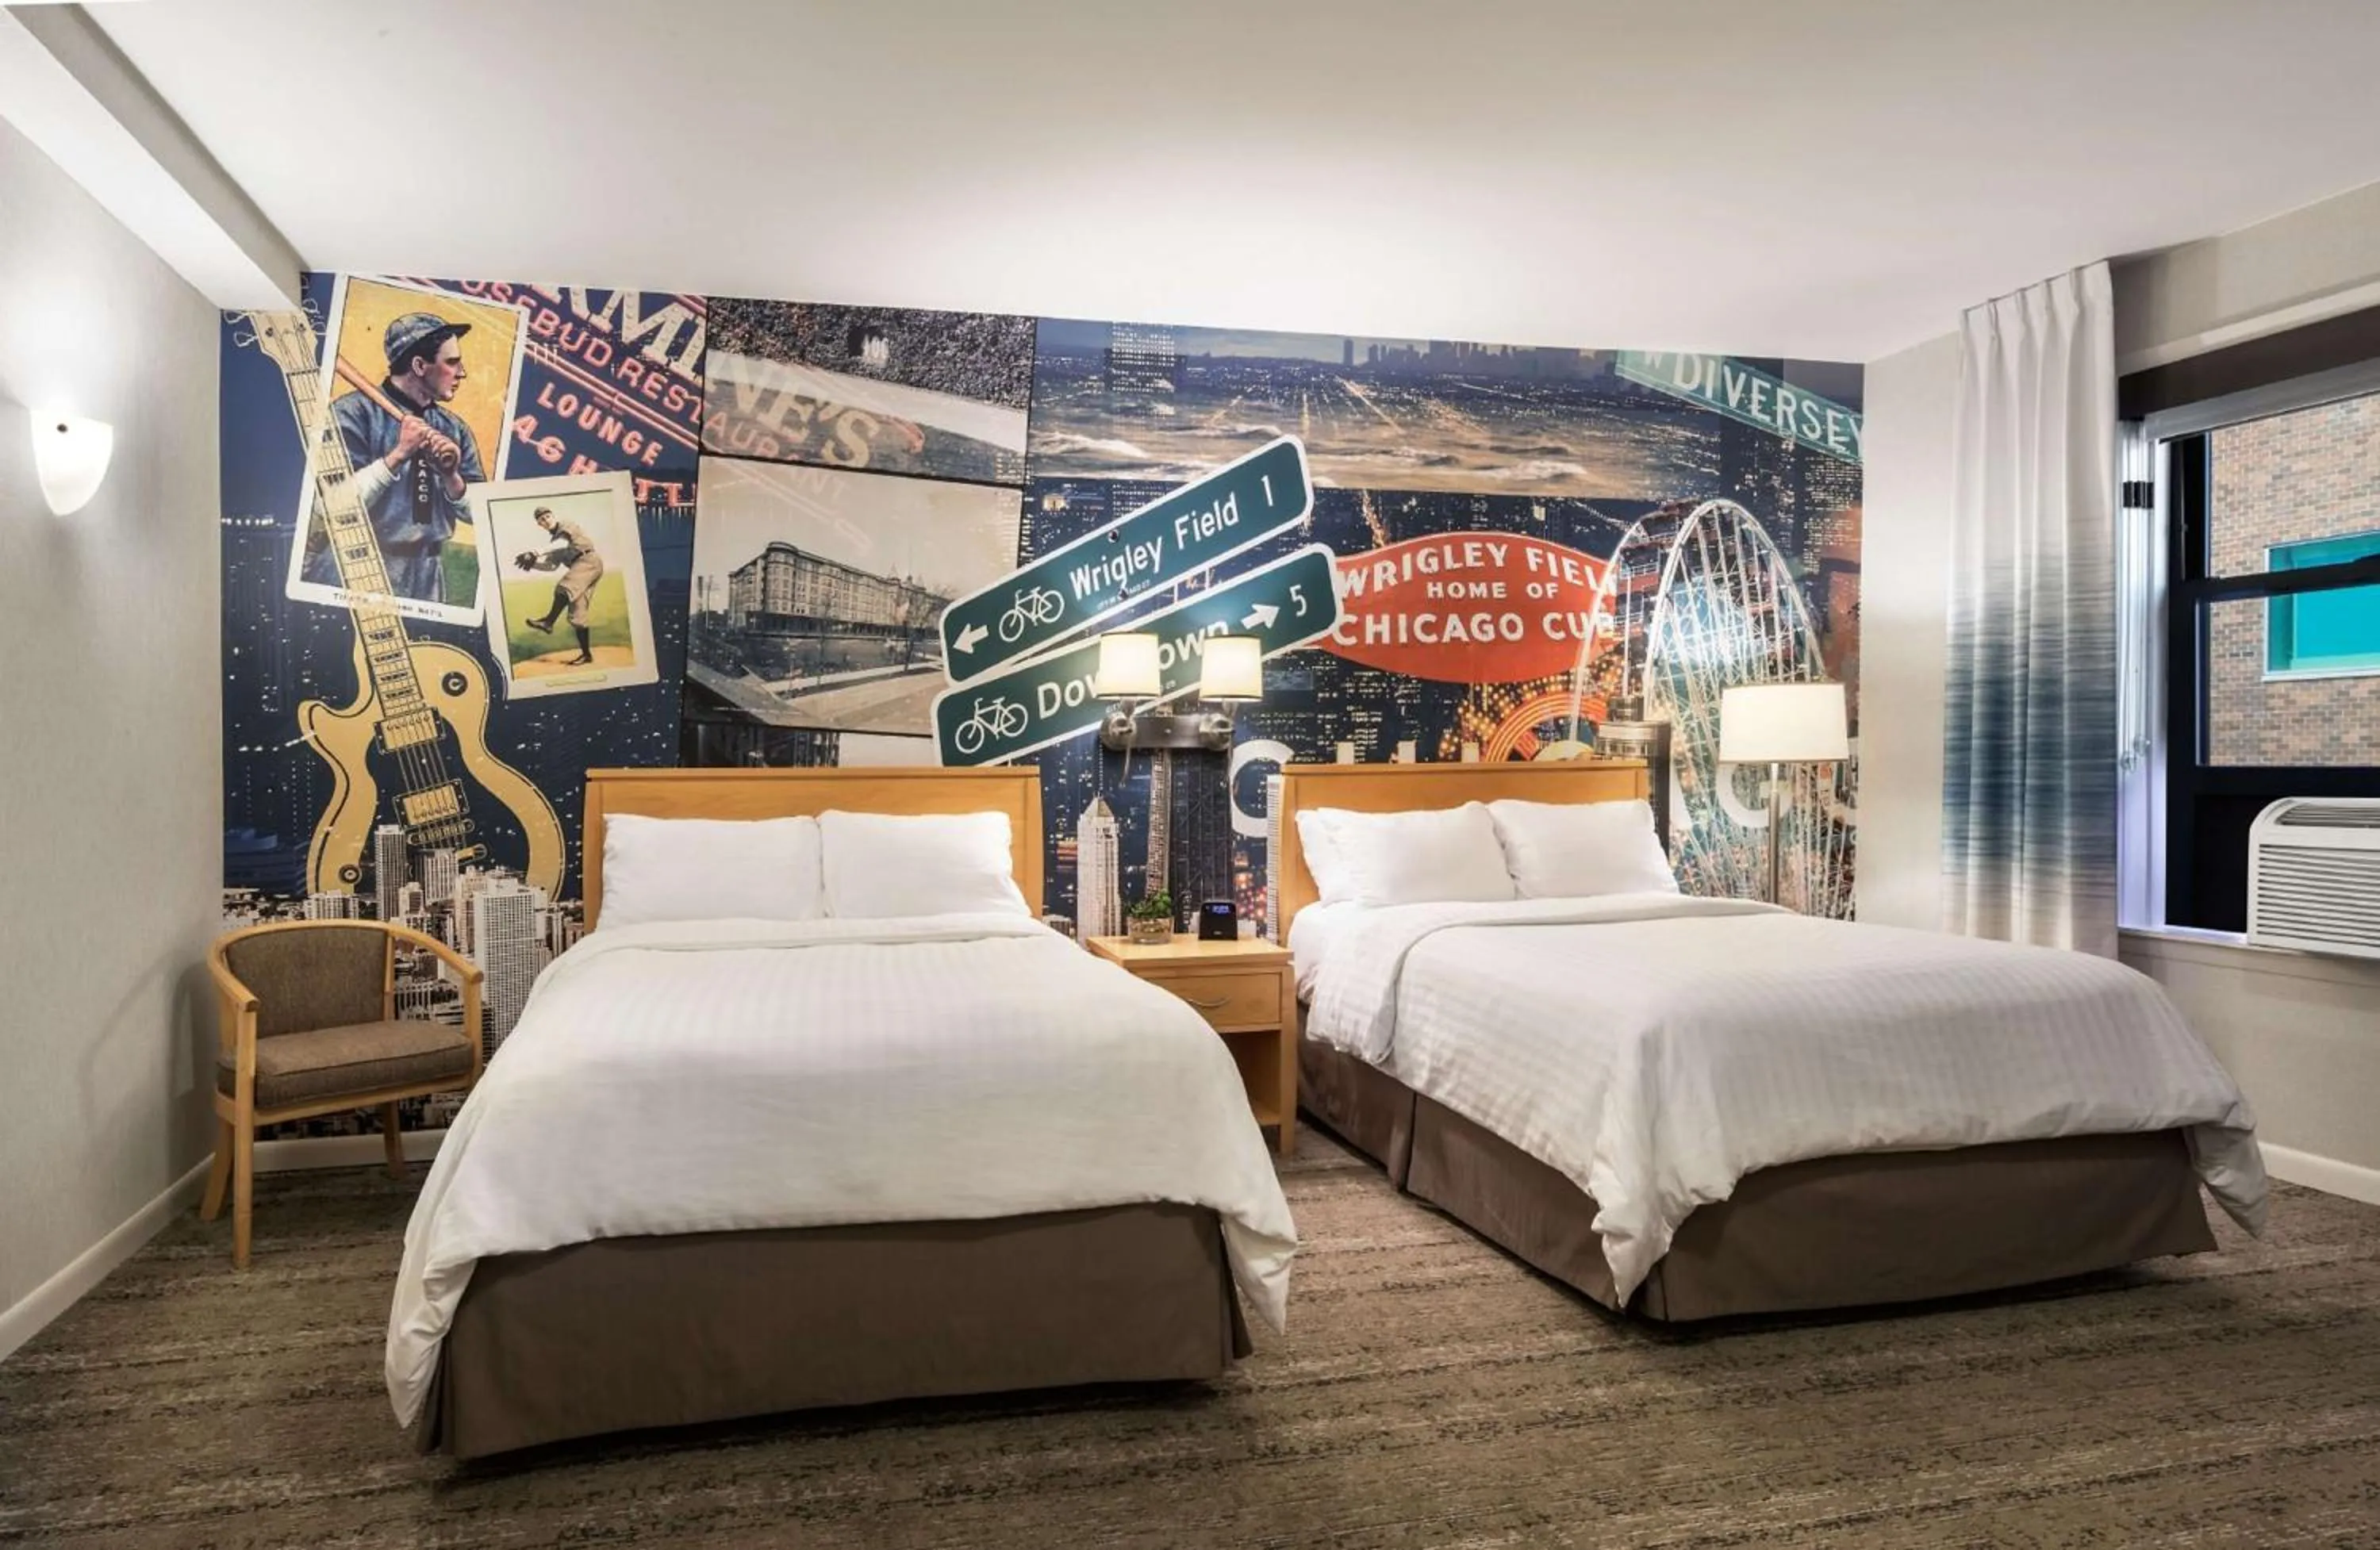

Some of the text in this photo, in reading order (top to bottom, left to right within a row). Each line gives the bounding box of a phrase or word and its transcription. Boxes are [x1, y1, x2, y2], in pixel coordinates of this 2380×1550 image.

[536, 382, 664, 466] LOUNGE
[1069, 535, 1163, 601] Wrigley
[1174, 492, 1241, 551] Field
[1261, 474, 1275, 508] 1
[1335, 541, 1509, 600] WRIGLEY
[1426, 581, 1559, 600] HOME OF
[1289, 583, 1308, 617] 5
[1334, 612, 1525, 646] CHICAGO
